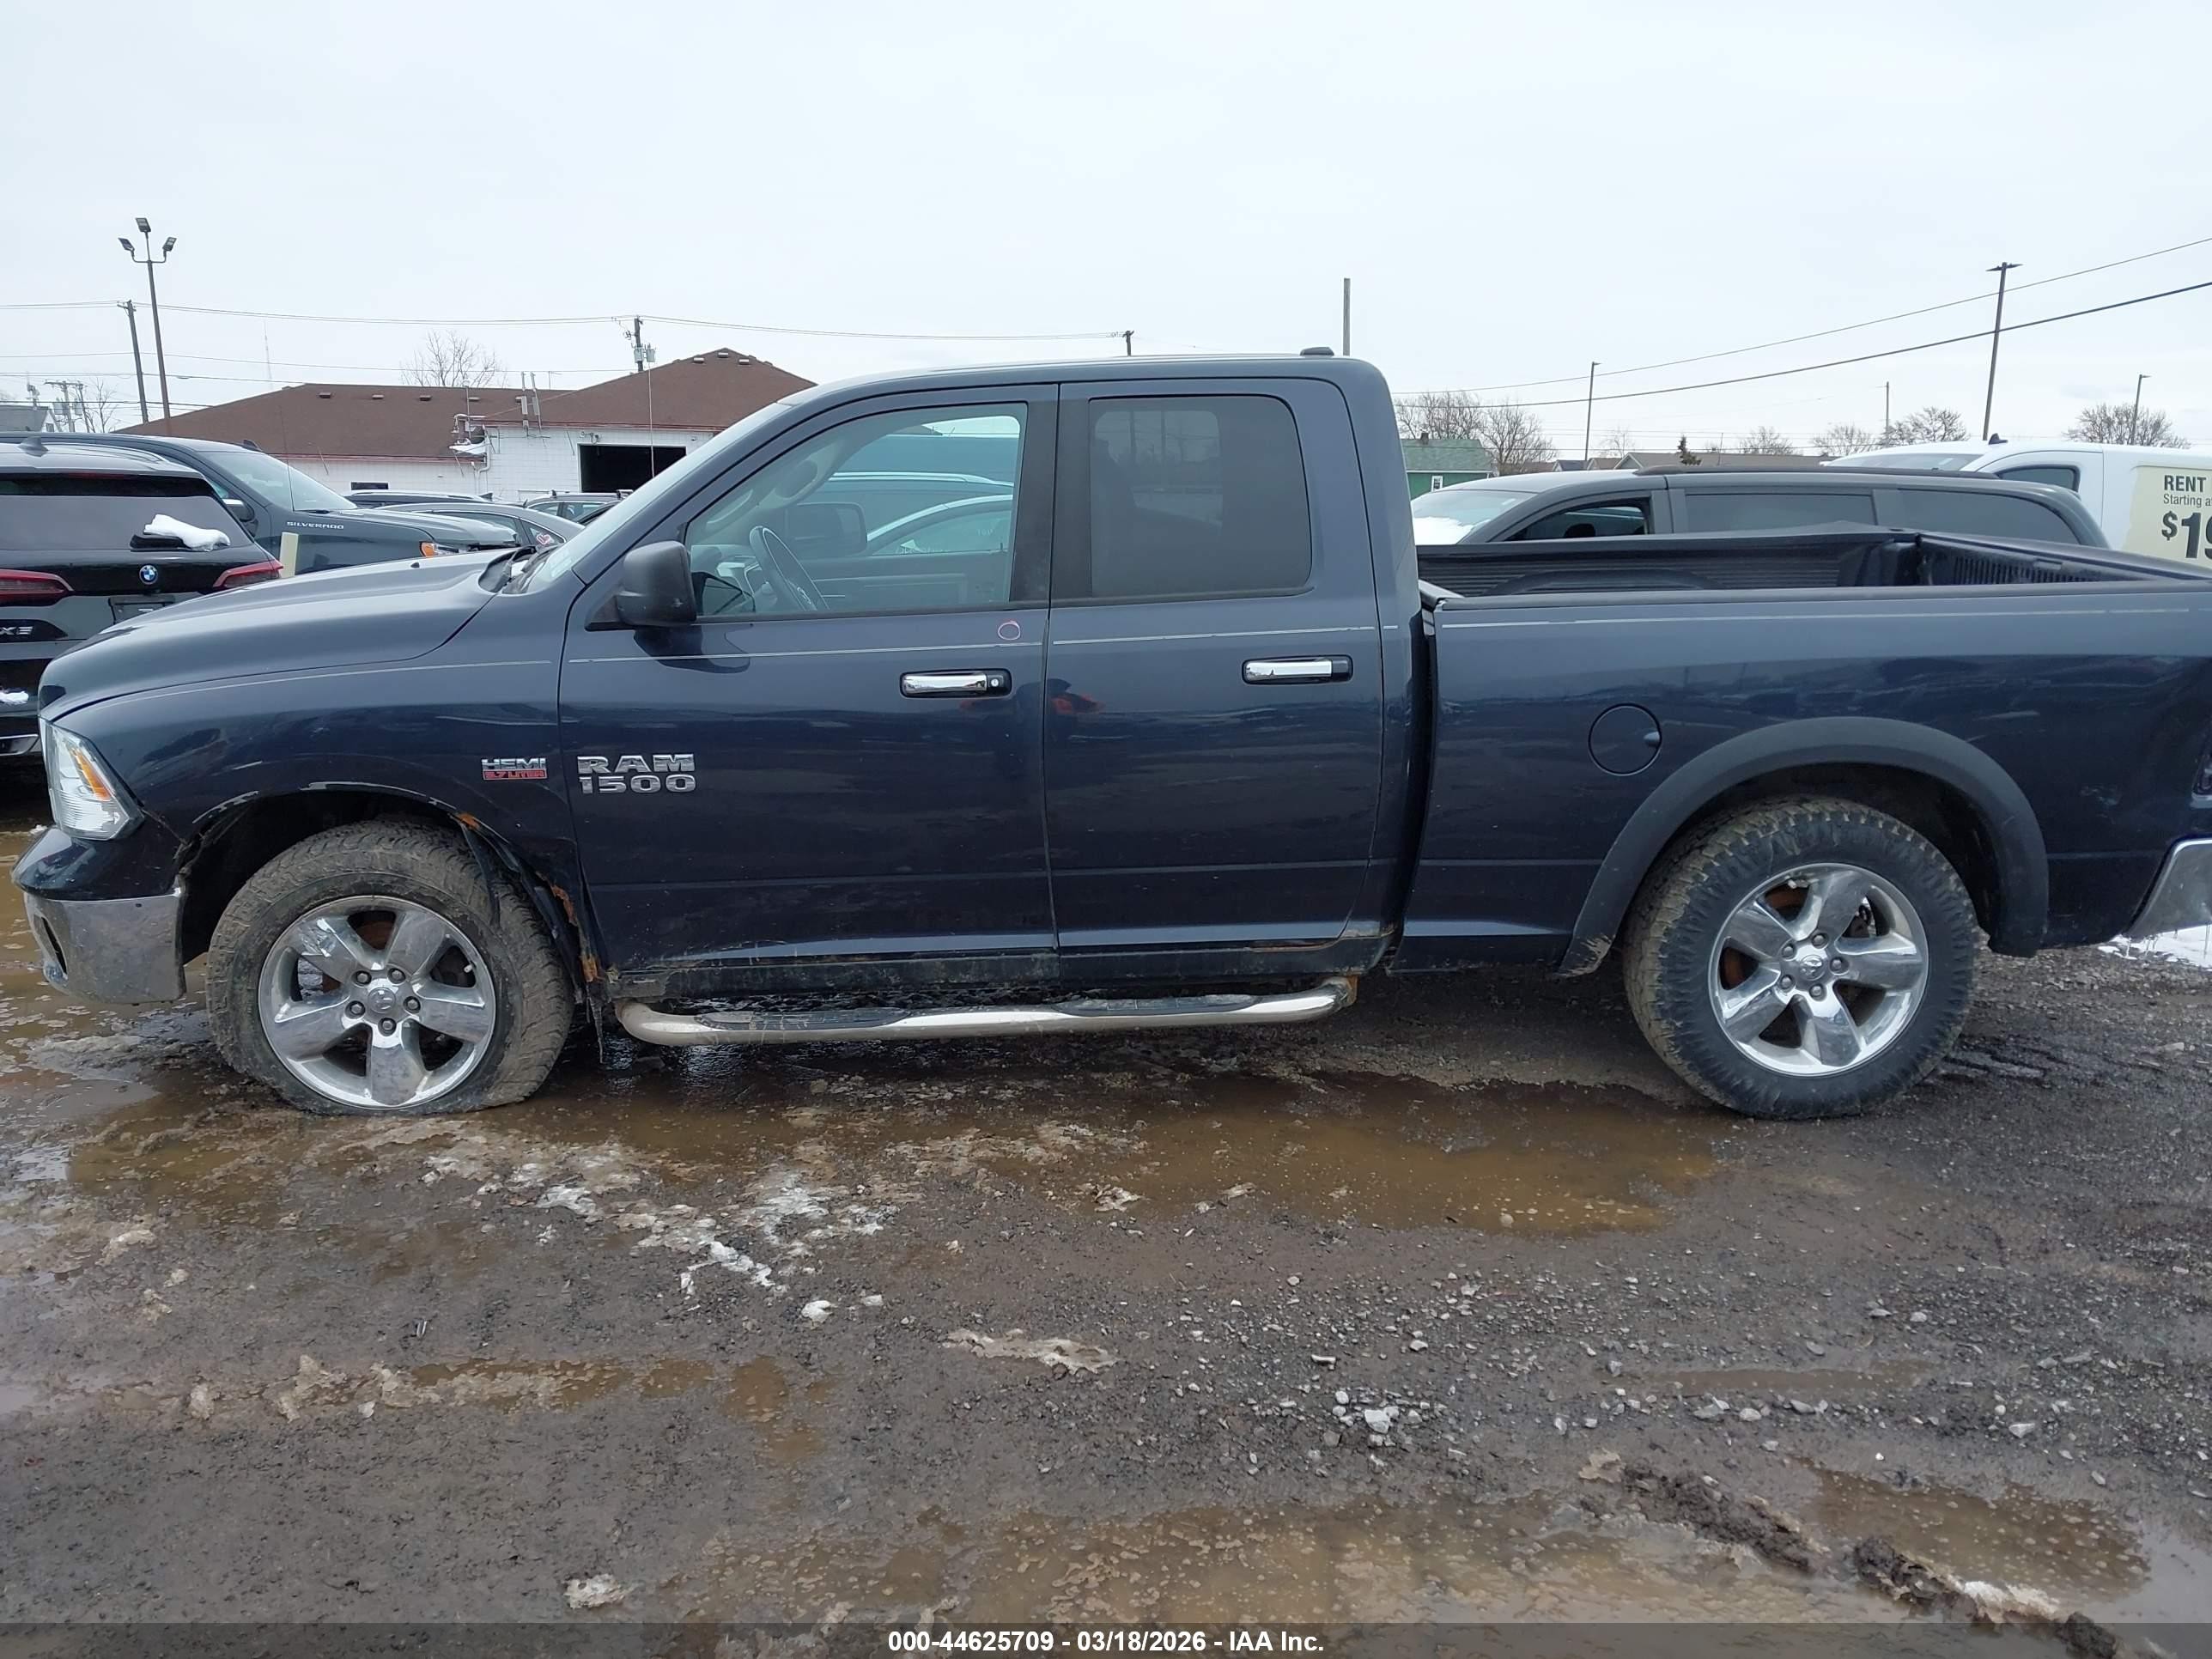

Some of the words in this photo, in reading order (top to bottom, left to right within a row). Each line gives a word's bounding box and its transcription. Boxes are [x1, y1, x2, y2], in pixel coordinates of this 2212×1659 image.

[2164, 475, 2206, 493] RENT
[2163, 493, 2202, 508] Starting
[287, 521, 344, 530] SILVERADO
[481, 757, 546, 770] HEMI
[577, 753, 696, 774] RAM
[579, 774, 696, 795] 1500
